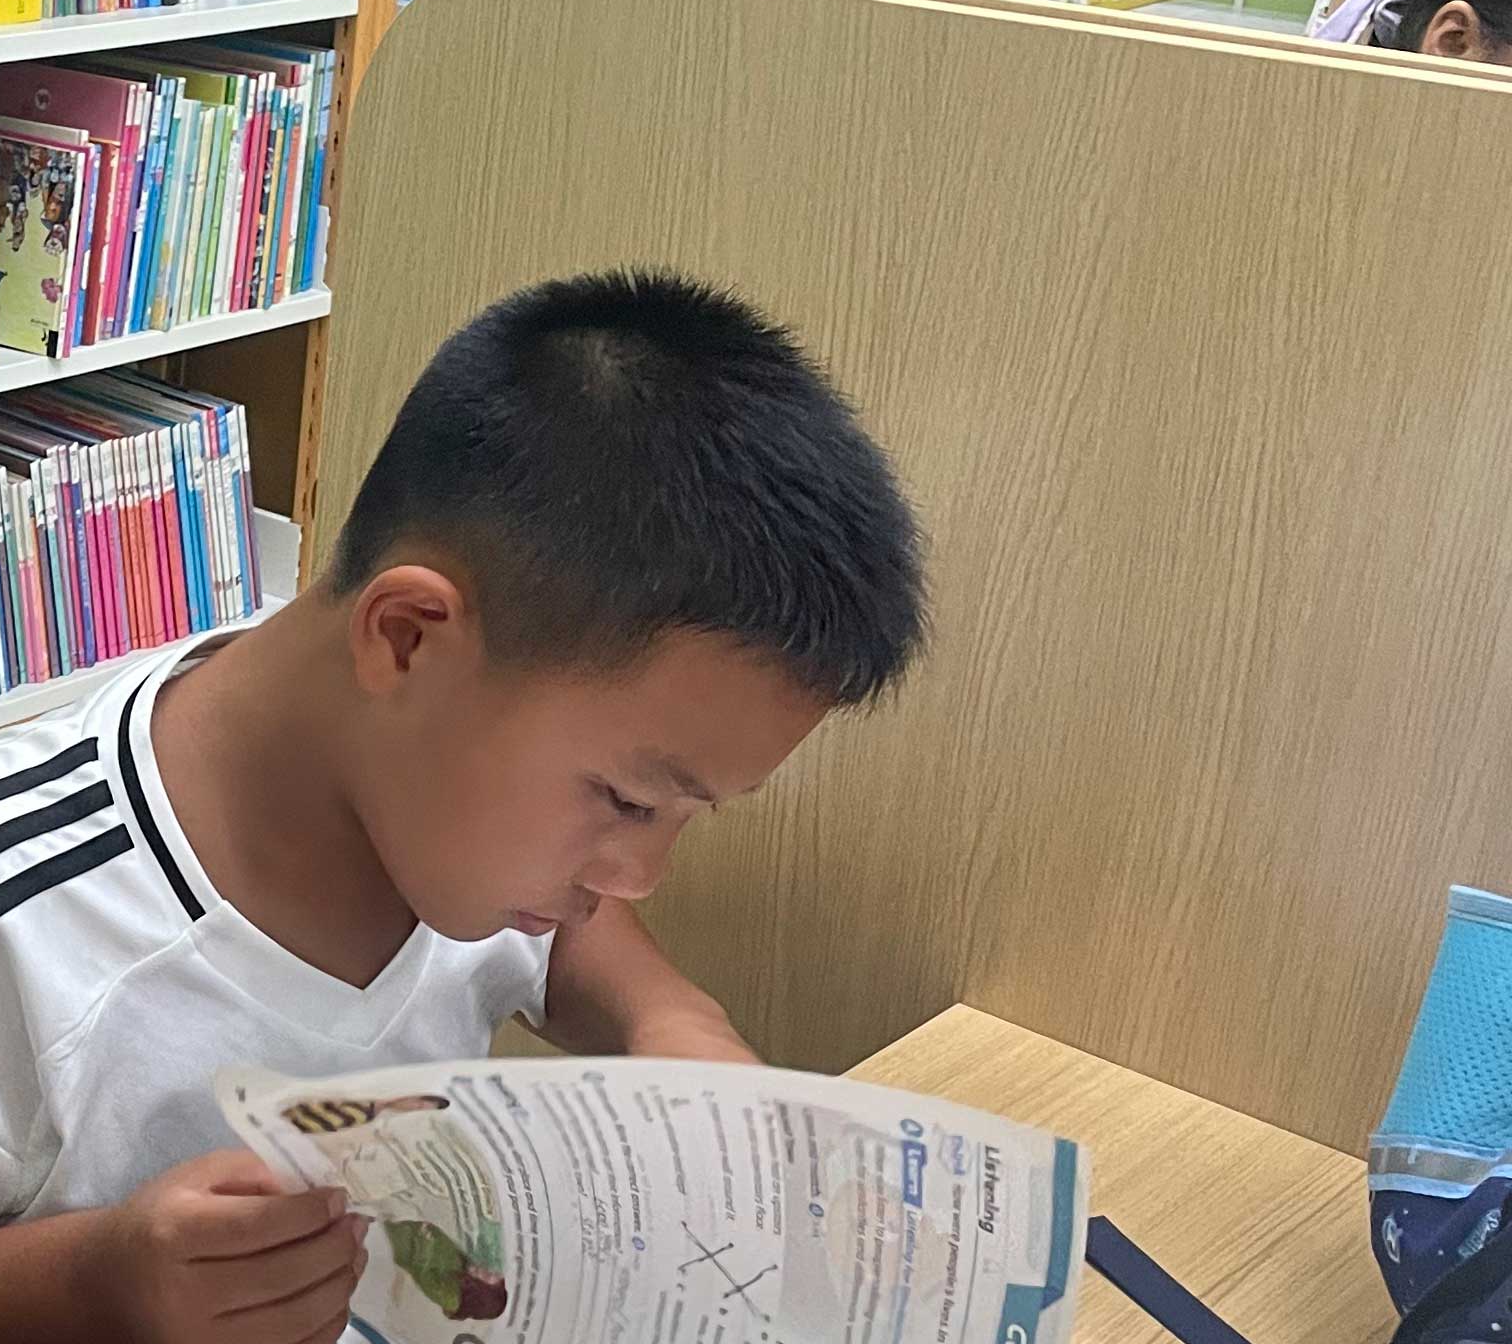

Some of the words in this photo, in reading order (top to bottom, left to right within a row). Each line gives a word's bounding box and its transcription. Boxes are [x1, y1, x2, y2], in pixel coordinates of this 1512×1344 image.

[978, 1145, 1004, 1234] Listening
[947, 1211, 965, 1242] were
[940, 1242, 963, 1295] people's
[938, 1297, 953, 1328] lives
[935, 1328, 948, 1343] in
